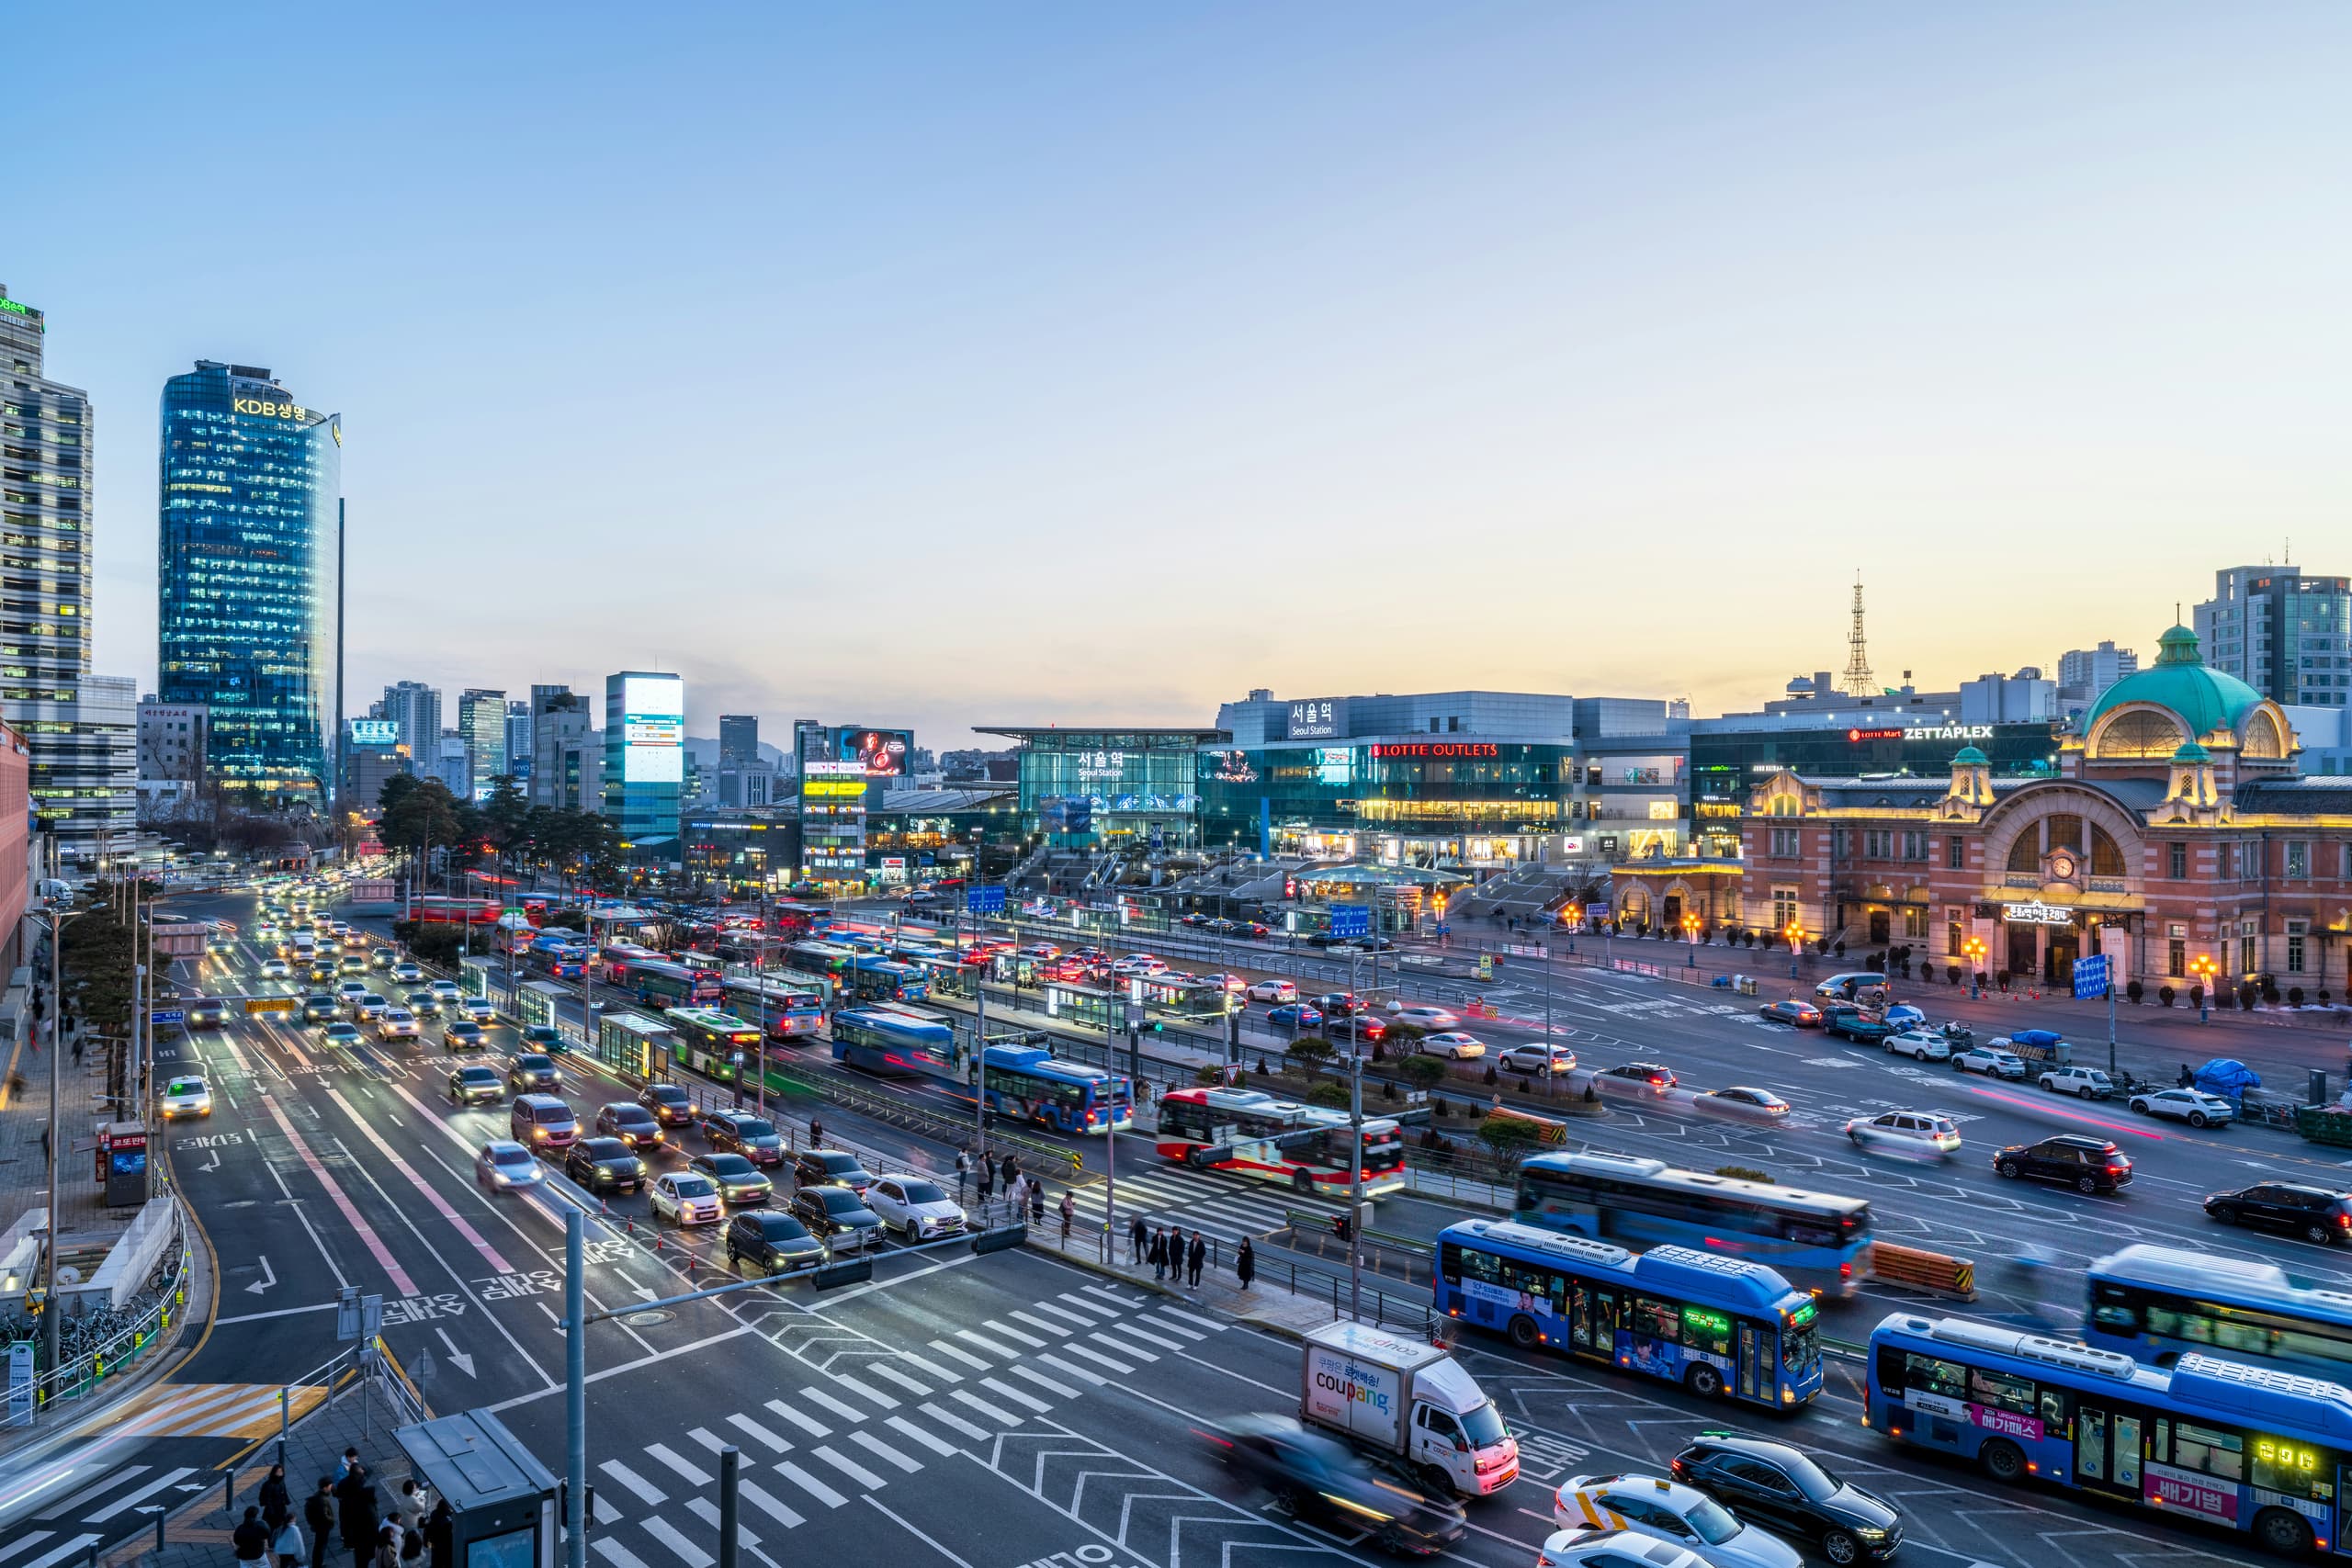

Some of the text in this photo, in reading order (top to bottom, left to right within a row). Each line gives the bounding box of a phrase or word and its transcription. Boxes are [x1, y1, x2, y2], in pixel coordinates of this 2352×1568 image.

[234, 398, 306, 421] KDB생명
[1292, 703, 1331, 723] 서울역
[1293, 725, 1331, 735] Seoul Station
[1905, 726, 1994, 740] ZETTAPLEX
[1079, 751, 1123, 767] 서울역
[1384, 744, 1498, 756] LOTTE OUTLETS
[1079, 768, 1123, 776] Seoul Station
[469, 1270, 562, 1301] 숭례문
[382, 1293, 468, 1326] 숭례문
[1318, 1357, 1341, 1374] 쿠팡은
[1317, 1372, 1389, 1416] coupang
[1982, 1415, 2036, 1439] 메가패스
[2159, 1480, 2222, 1513] 배기범
